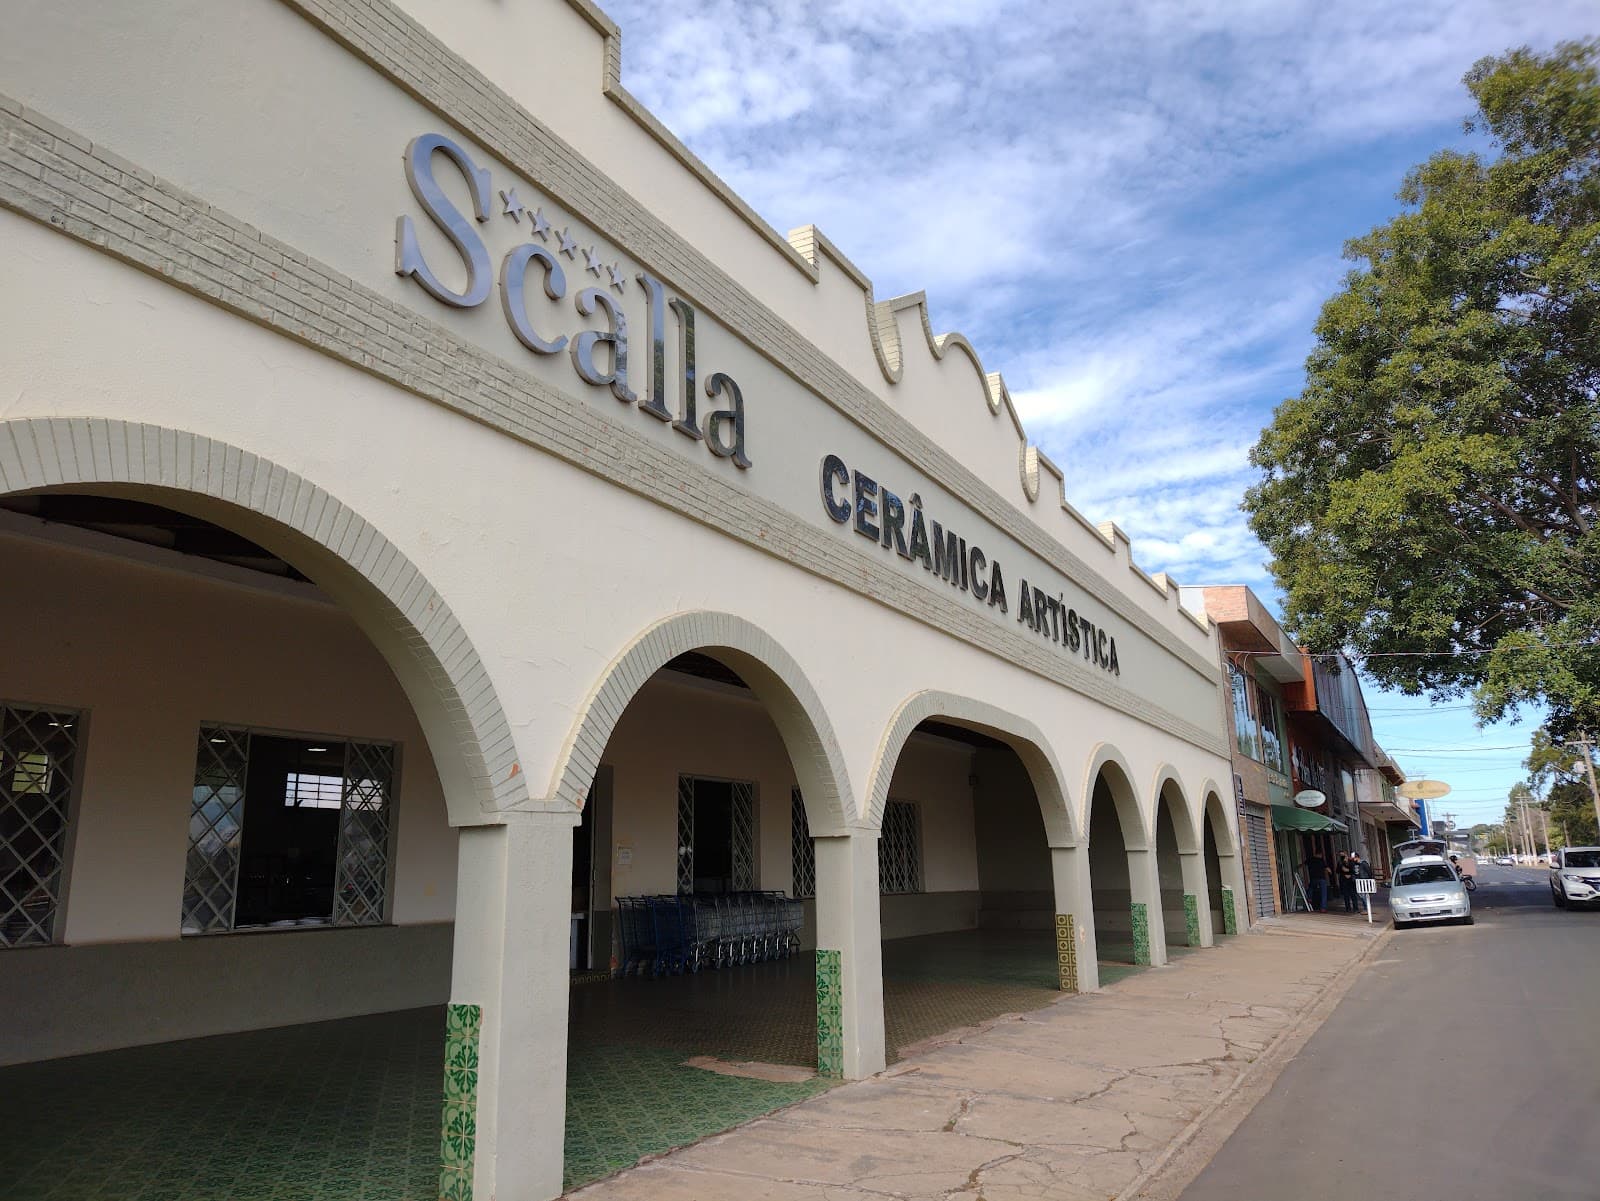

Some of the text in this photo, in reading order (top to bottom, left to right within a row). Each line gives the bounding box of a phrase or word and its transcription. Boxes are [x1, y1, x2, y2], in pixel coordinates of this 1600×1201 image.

[395, 133, 752, 469] Scalla
[819, 454, 1120, 676] CERÂMICA ARTÍSTICA
